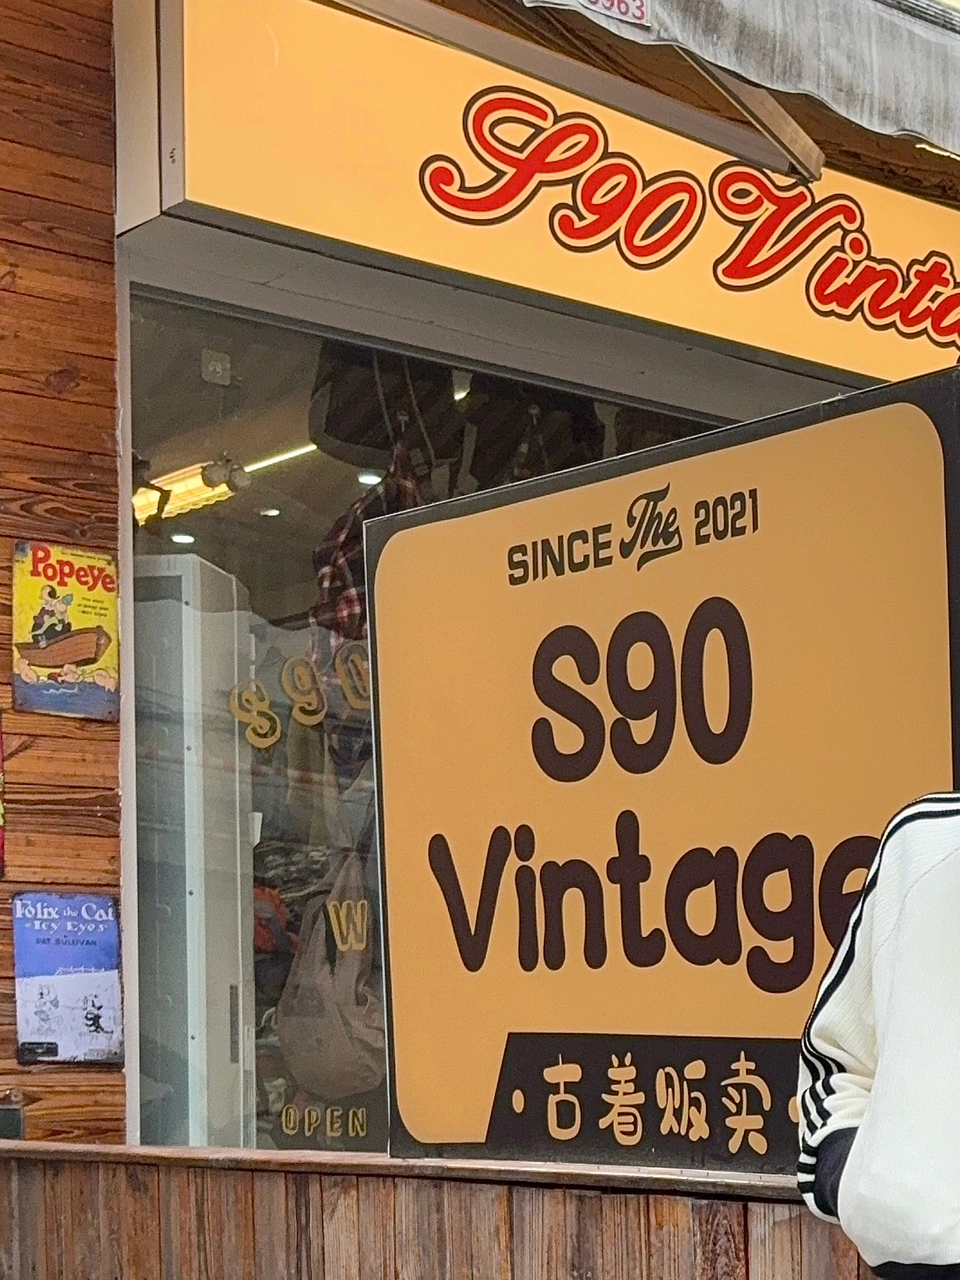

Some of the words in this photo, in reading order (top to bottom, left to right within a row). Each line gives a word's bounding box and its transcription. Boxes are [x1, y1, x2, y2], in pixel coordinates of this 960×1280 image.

[508, 523, 613, 586] SINCE
[619, 482, 683, 572] The
[694, 488, 759, 547] 2021
[30, 544, 117, 593] Popeye
[531, 596, 753, 783] S90
[81, 902, 116, 921] Cat
[281, 1104, 367, 1138] OPEN
